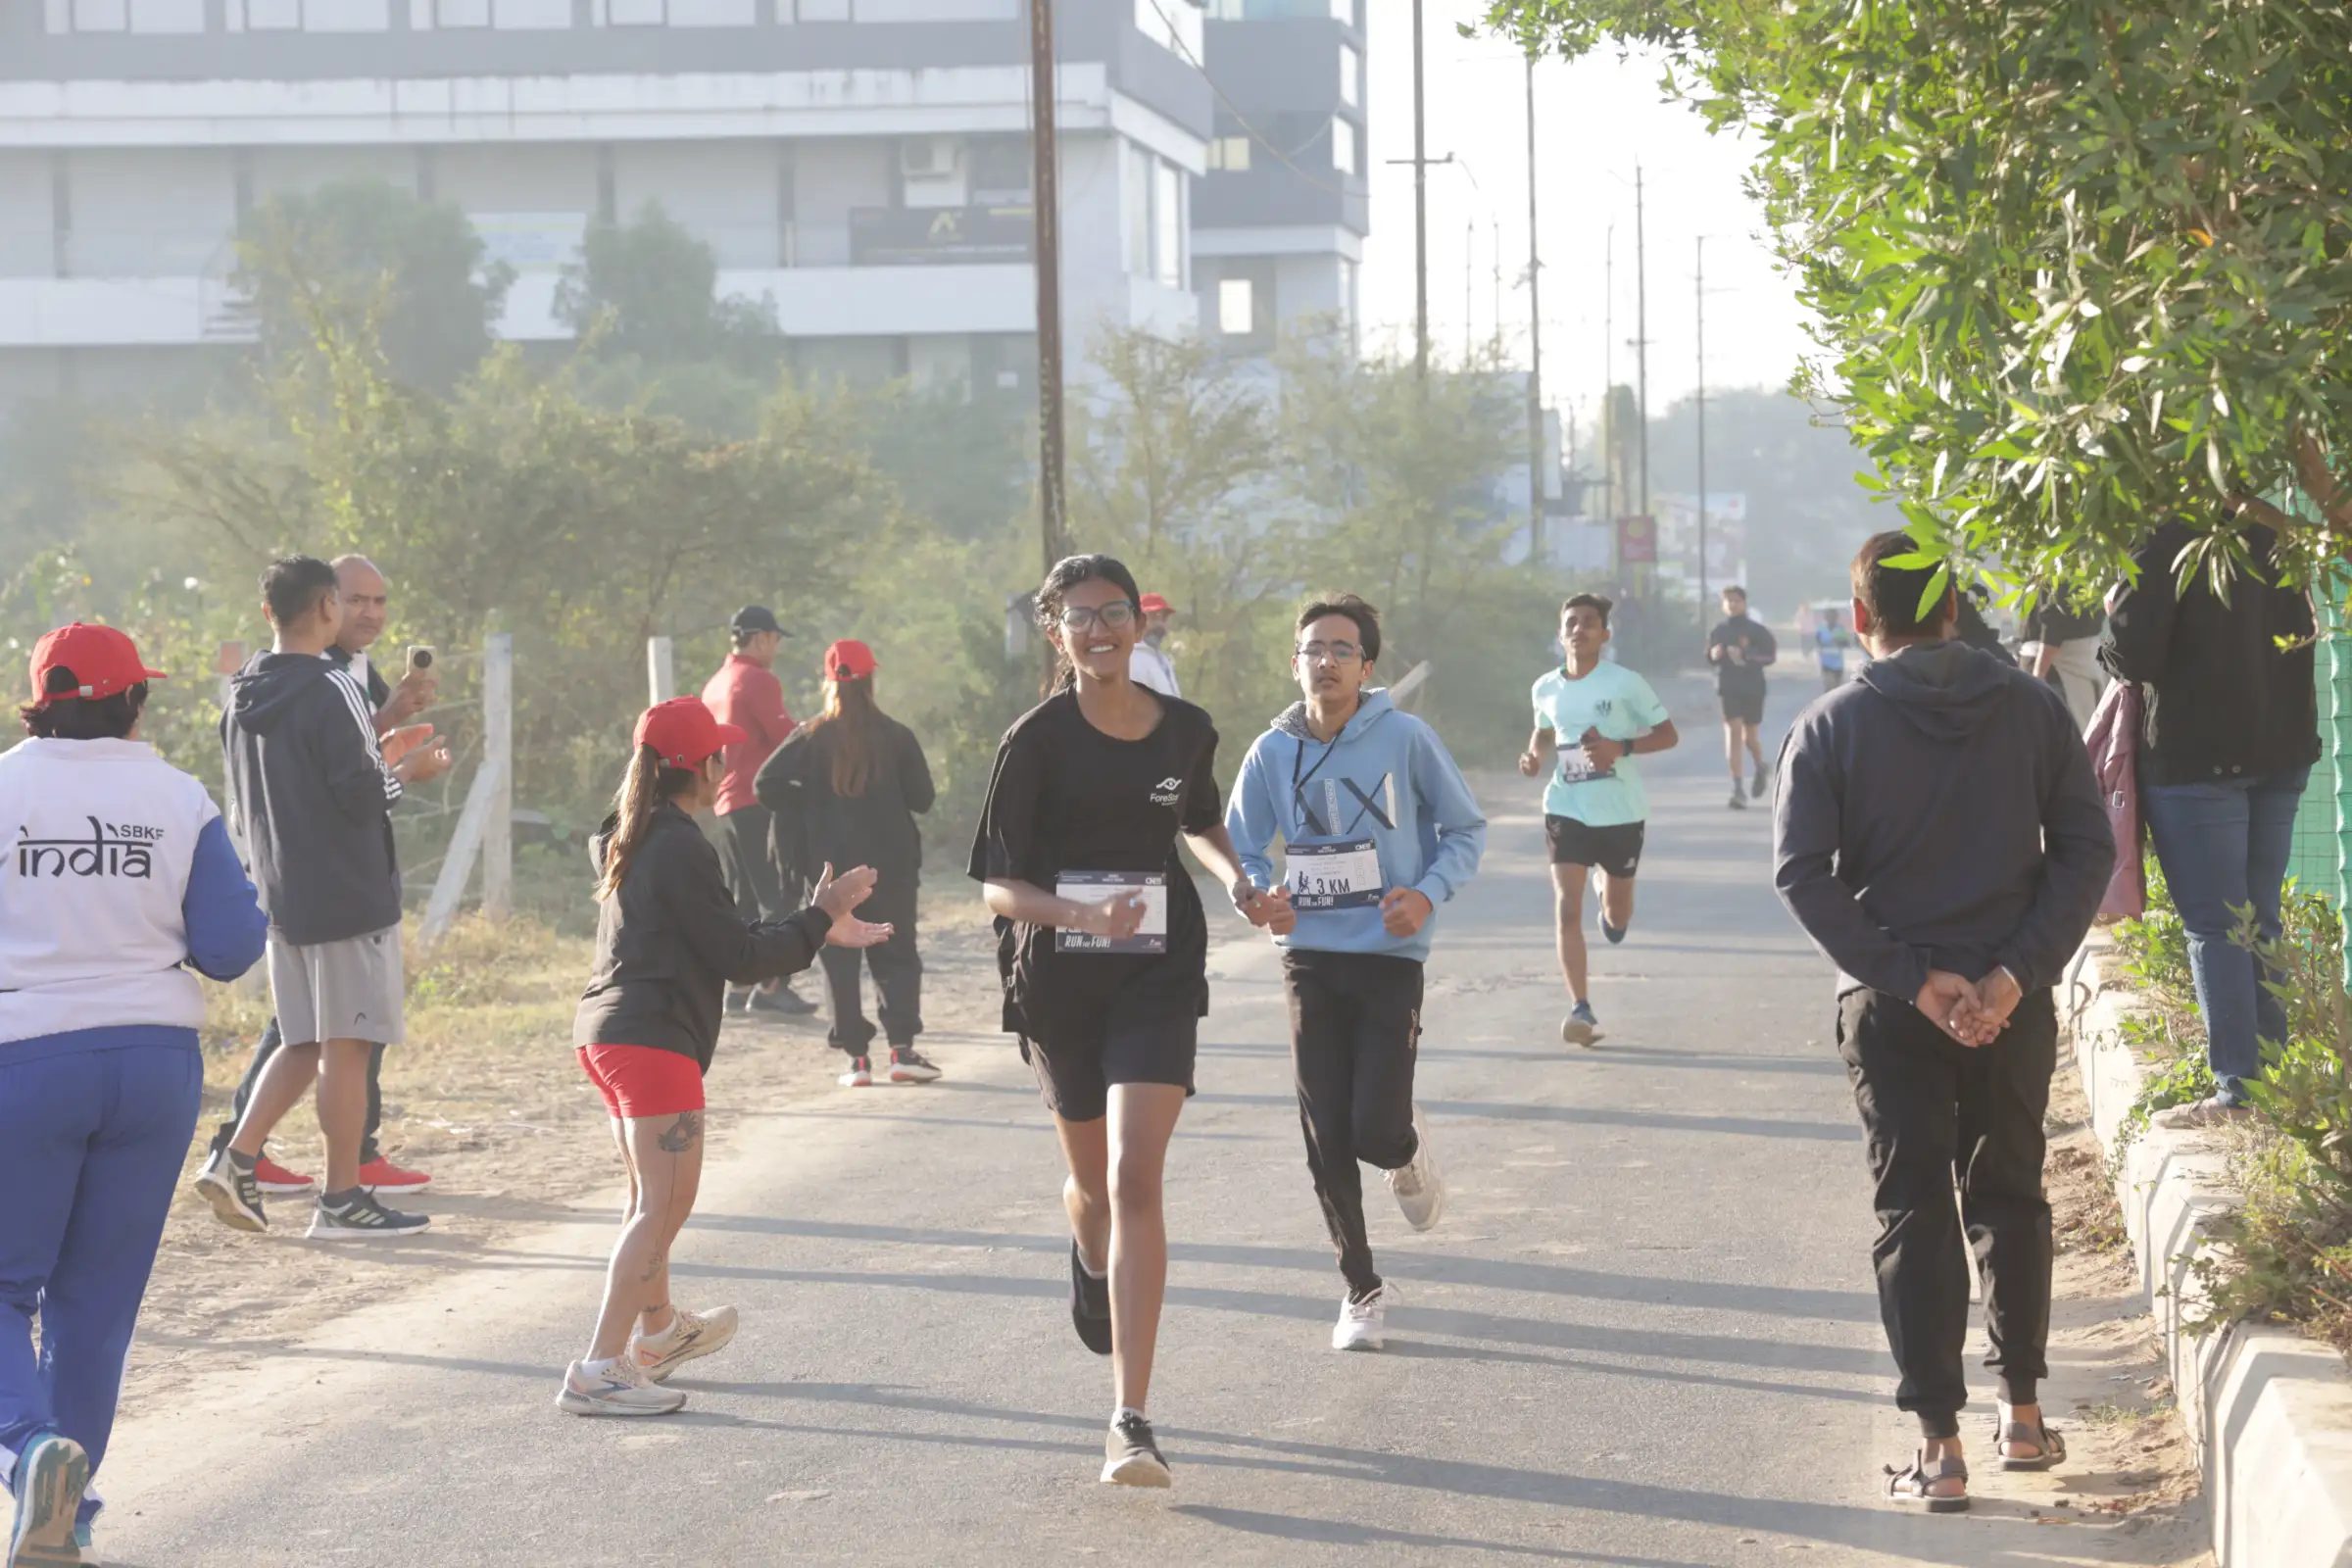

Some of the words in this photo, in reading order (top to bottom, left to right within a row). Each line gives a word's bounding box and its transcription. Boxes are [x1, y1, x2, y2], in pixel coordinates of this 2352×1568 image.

[121, 824, 165, 840] SBKF
[18, 815, 153, 879] india
[1316, 878, 1325, 895] 3
[1329, 878, 1350, 894] KM
[1298, 896, 1311, 906] RUN
[1064, 935, 1084, 948] RUN
[1091, 936, 1111, 949] FUN!
